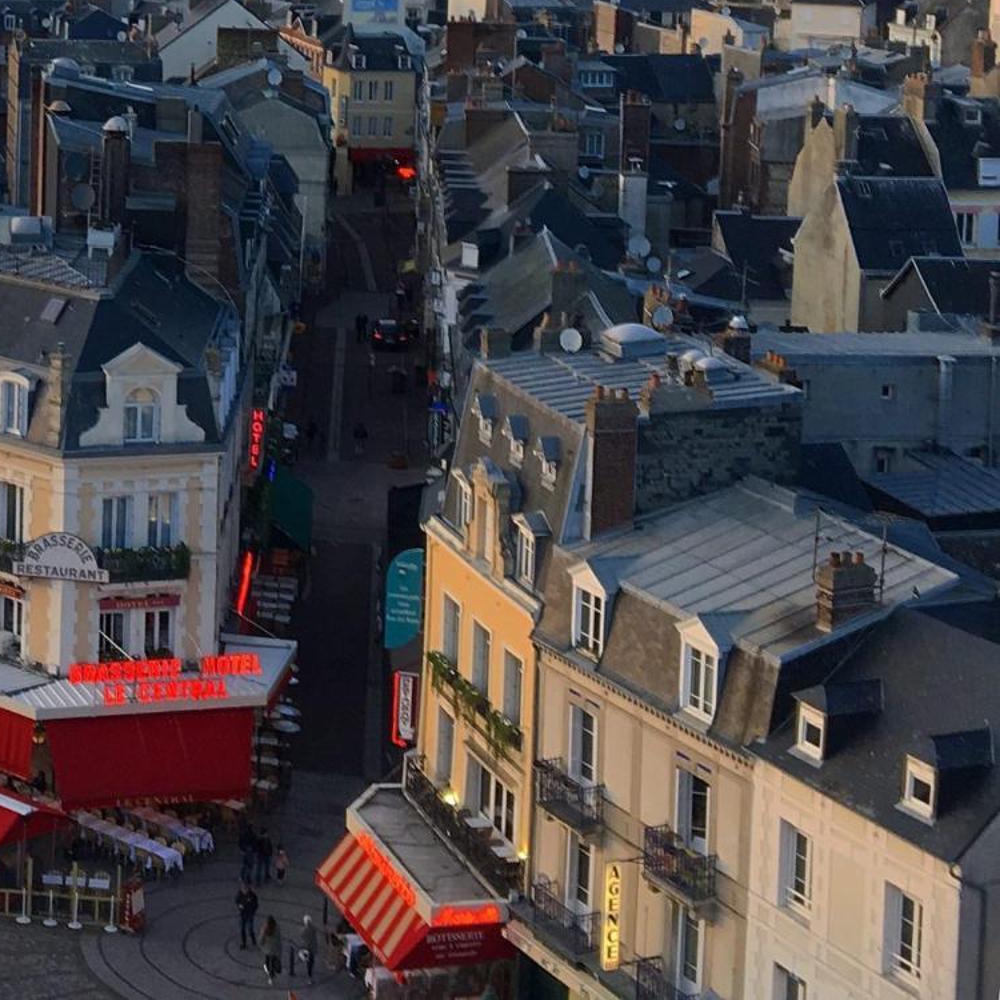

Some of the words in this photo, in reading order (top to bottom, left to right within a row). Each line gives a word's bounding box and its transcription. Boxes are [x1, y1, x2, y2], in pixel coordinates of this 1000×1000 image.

[250, 410, 264, 467] HOTEL
[28, 534, 93, 564] BRASSERIE
[16, 564, 106, 582] RESTAURANT
[69, 658, 182, 684] BRASSERIE
[201, 652, 263, 676] HOTEL
[104, 684, 126, 706] LE
[138, 679, 229, 702] CENTRAL
[607, 866, 620, 959] AGENCE
